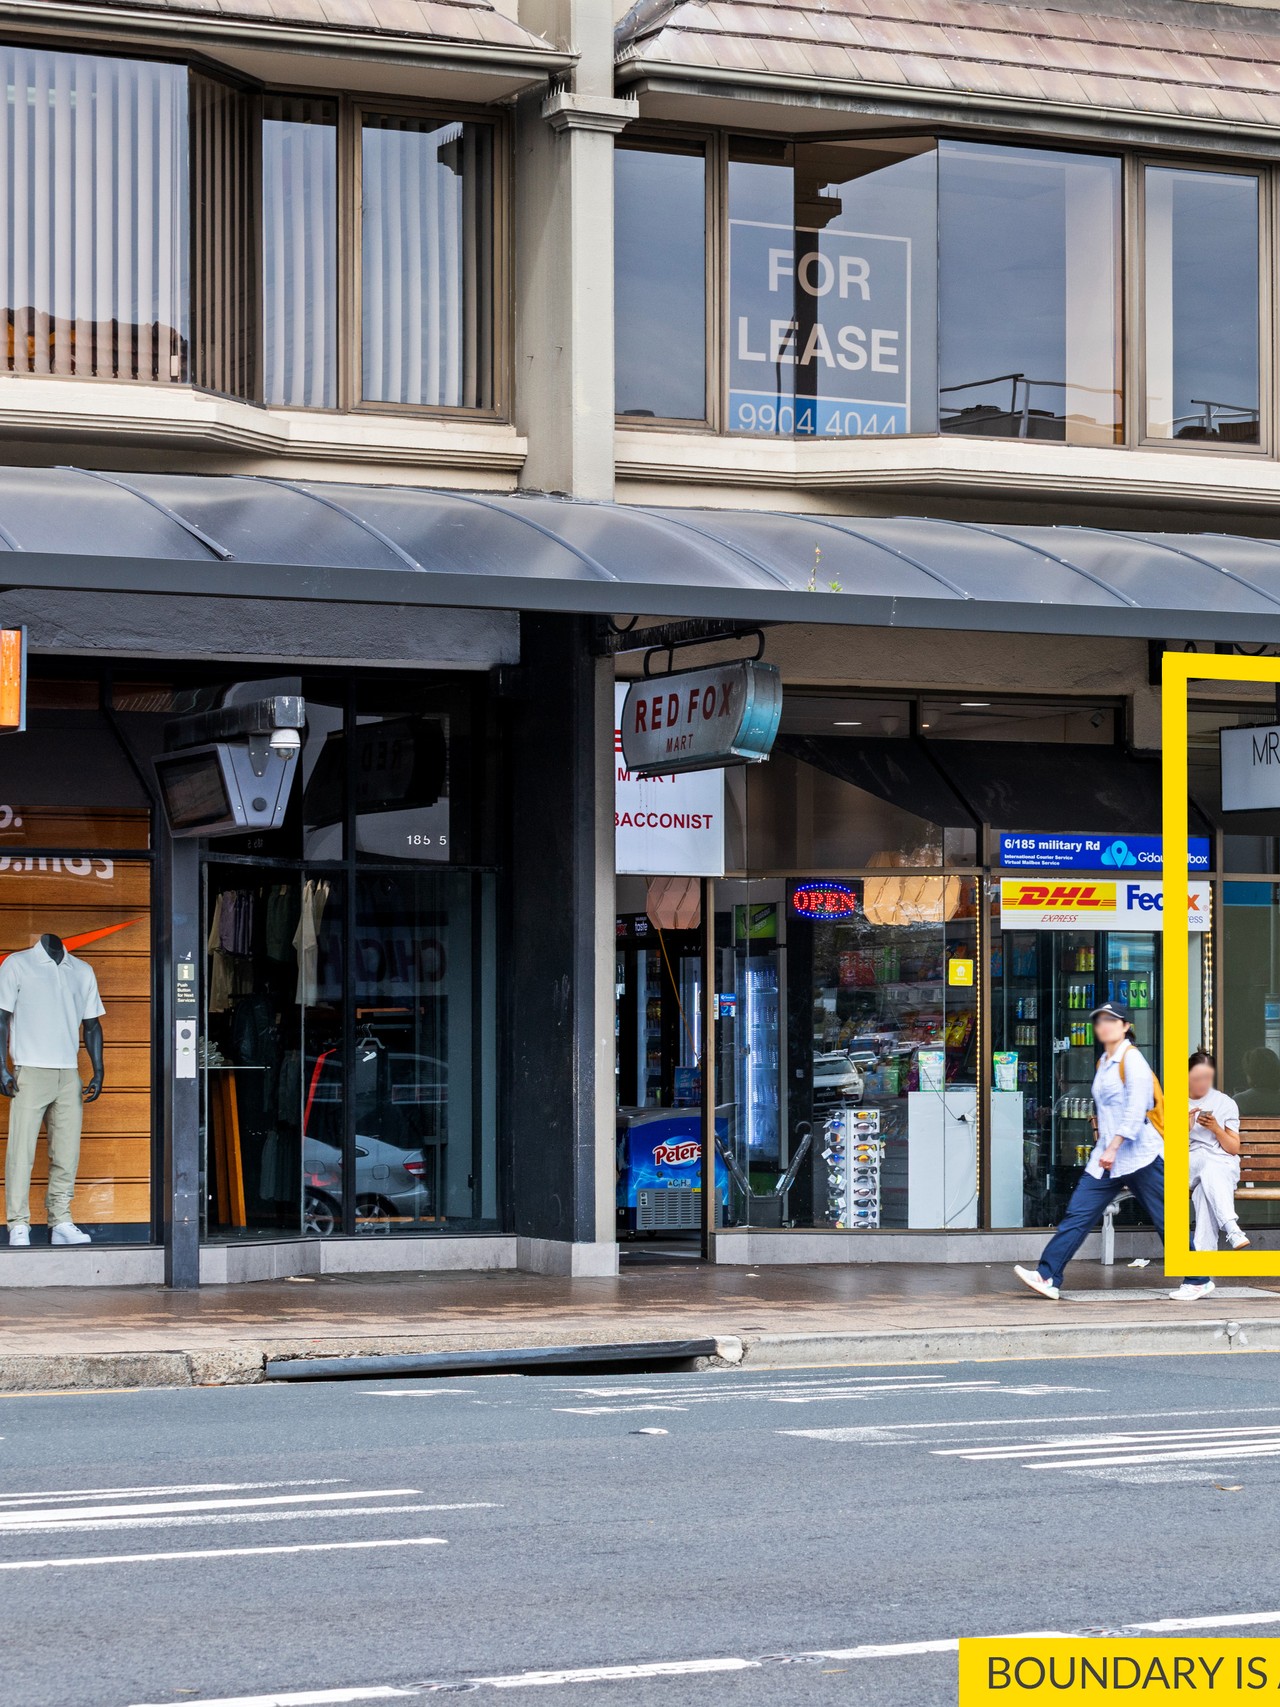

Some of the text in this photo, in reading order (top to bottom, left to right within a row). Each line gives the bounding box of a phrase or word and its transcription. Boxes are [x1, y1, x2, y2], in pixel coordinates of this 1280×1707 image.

[769, 248, 871, 300] FOR
[737, 316, 899, 374] LEASE
[738, 403, 896, 436] 9904 4044
[635, 682, 735, 733] RED FOX
[666, 734, 694, 753] MART
[1252, 732, 1280, 766] MR
[406, 835, 447, 845] 185 5
[1004, 838, 1100, 853] 6/185 military Rd
[793, 891, 856, 911] OPEN
[1017, 886, 1102, 906] DHL
[1041, 914, 1079, 922] EXPRESS
[653, 1141, 702, 1166] Peters
